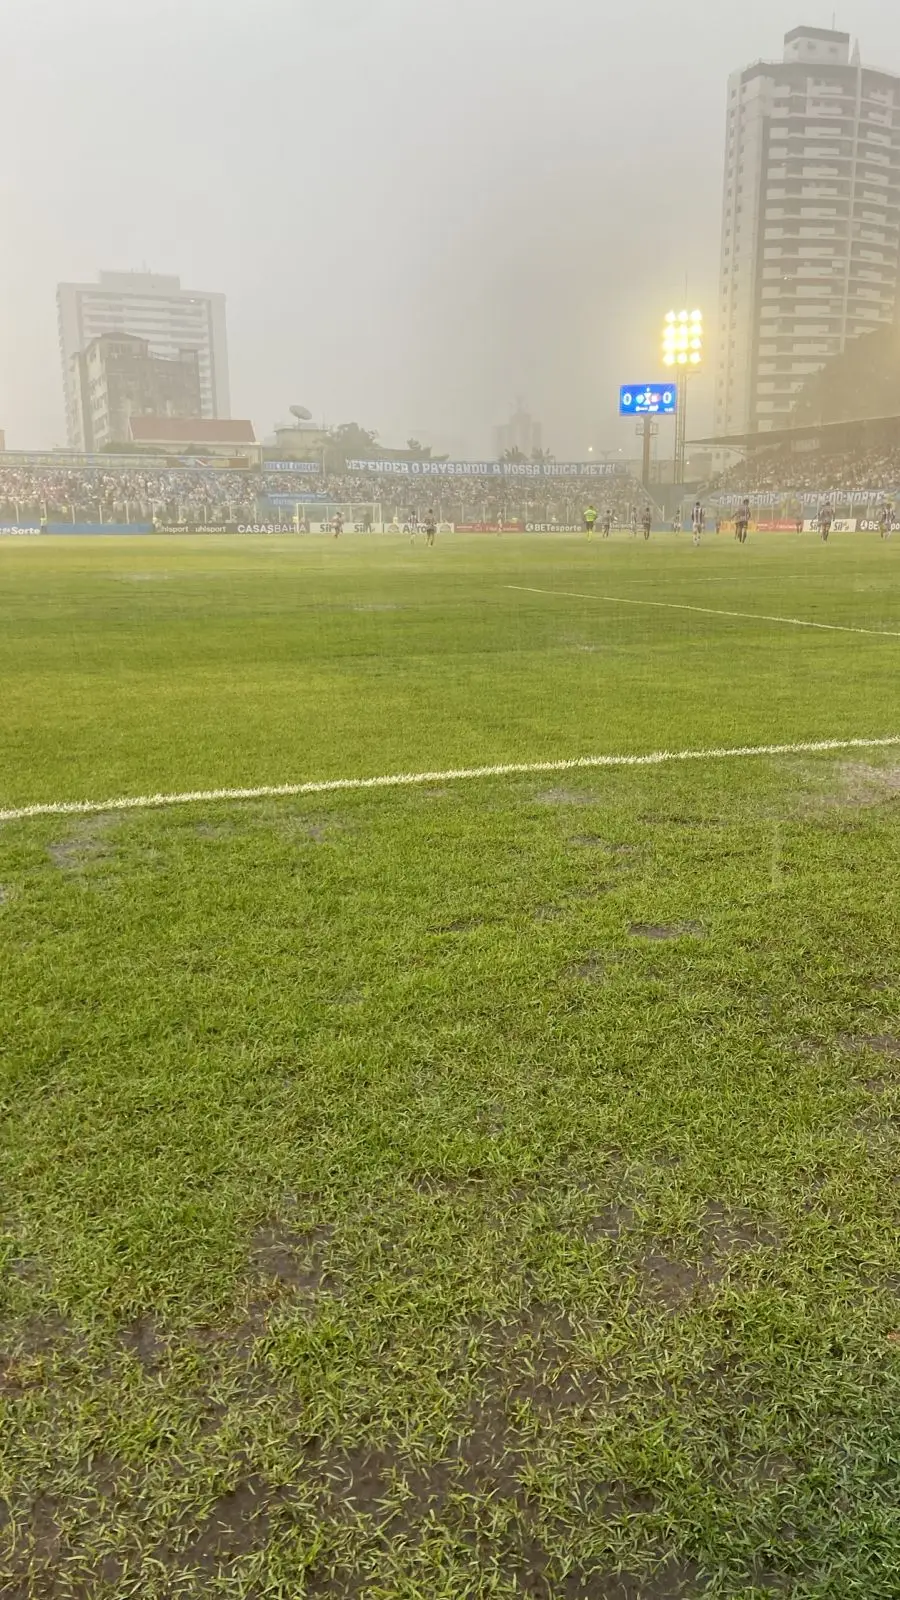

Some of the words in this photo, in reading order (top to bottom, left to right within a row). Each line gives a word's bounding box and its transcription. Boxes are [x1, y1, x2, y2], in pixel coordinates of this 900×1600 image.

[623, 393, 632, 405] 0
[663, 392, 672, 404] 0
[411, 463, 419, 473] O
[423, 463, 487, 474] PAYSANDU
[491, 464, 501, 474] A
[504, 464, 540, 475] NOSSA
